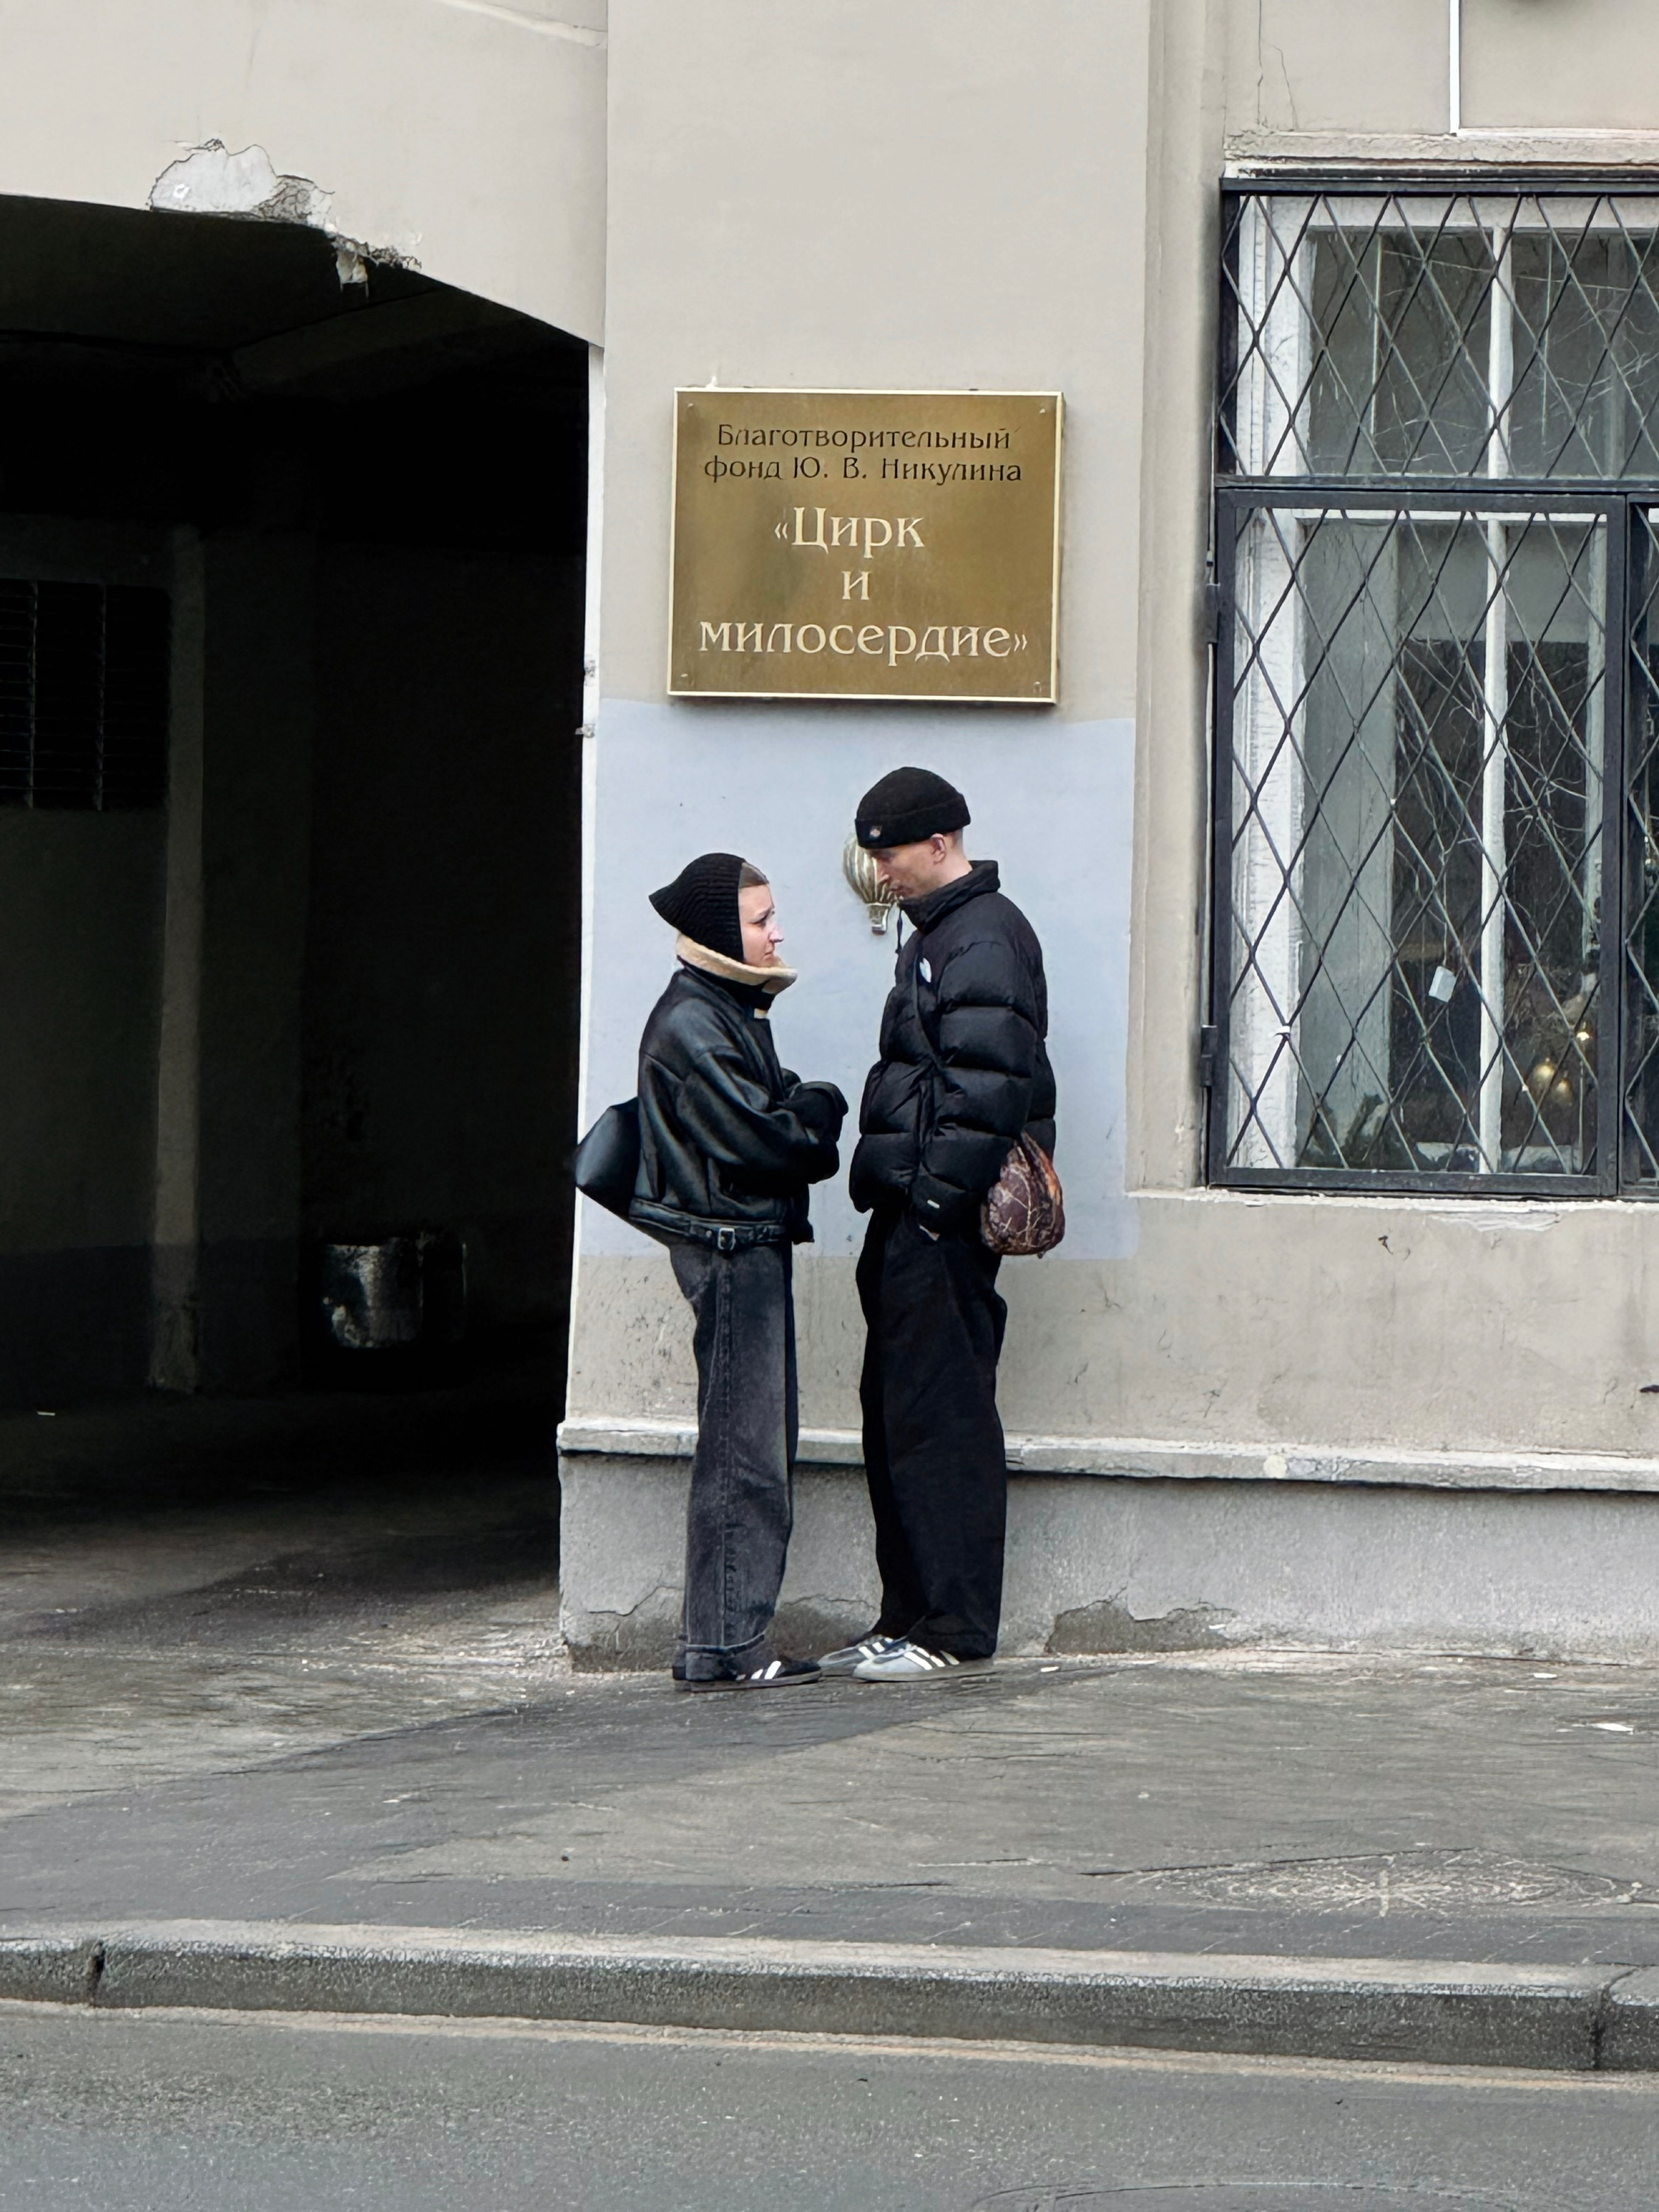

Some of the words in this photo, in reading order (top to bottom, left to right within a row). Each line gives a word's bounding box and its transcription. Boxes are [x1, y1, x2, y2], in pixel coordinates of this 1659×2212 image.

[717, 424, 1010, 453] Благотворительный
[704, 455, 782, 483] фонд
[793, 456, 828, 479] Ю.
[842, 457, 867, 480] В.
[881, 458, 1022, 485] Никулина
[774, 506, 925, 559] «Цирк
[841, 570, 872, 601] и
[698, 620, 1028, 667] милосердие»
